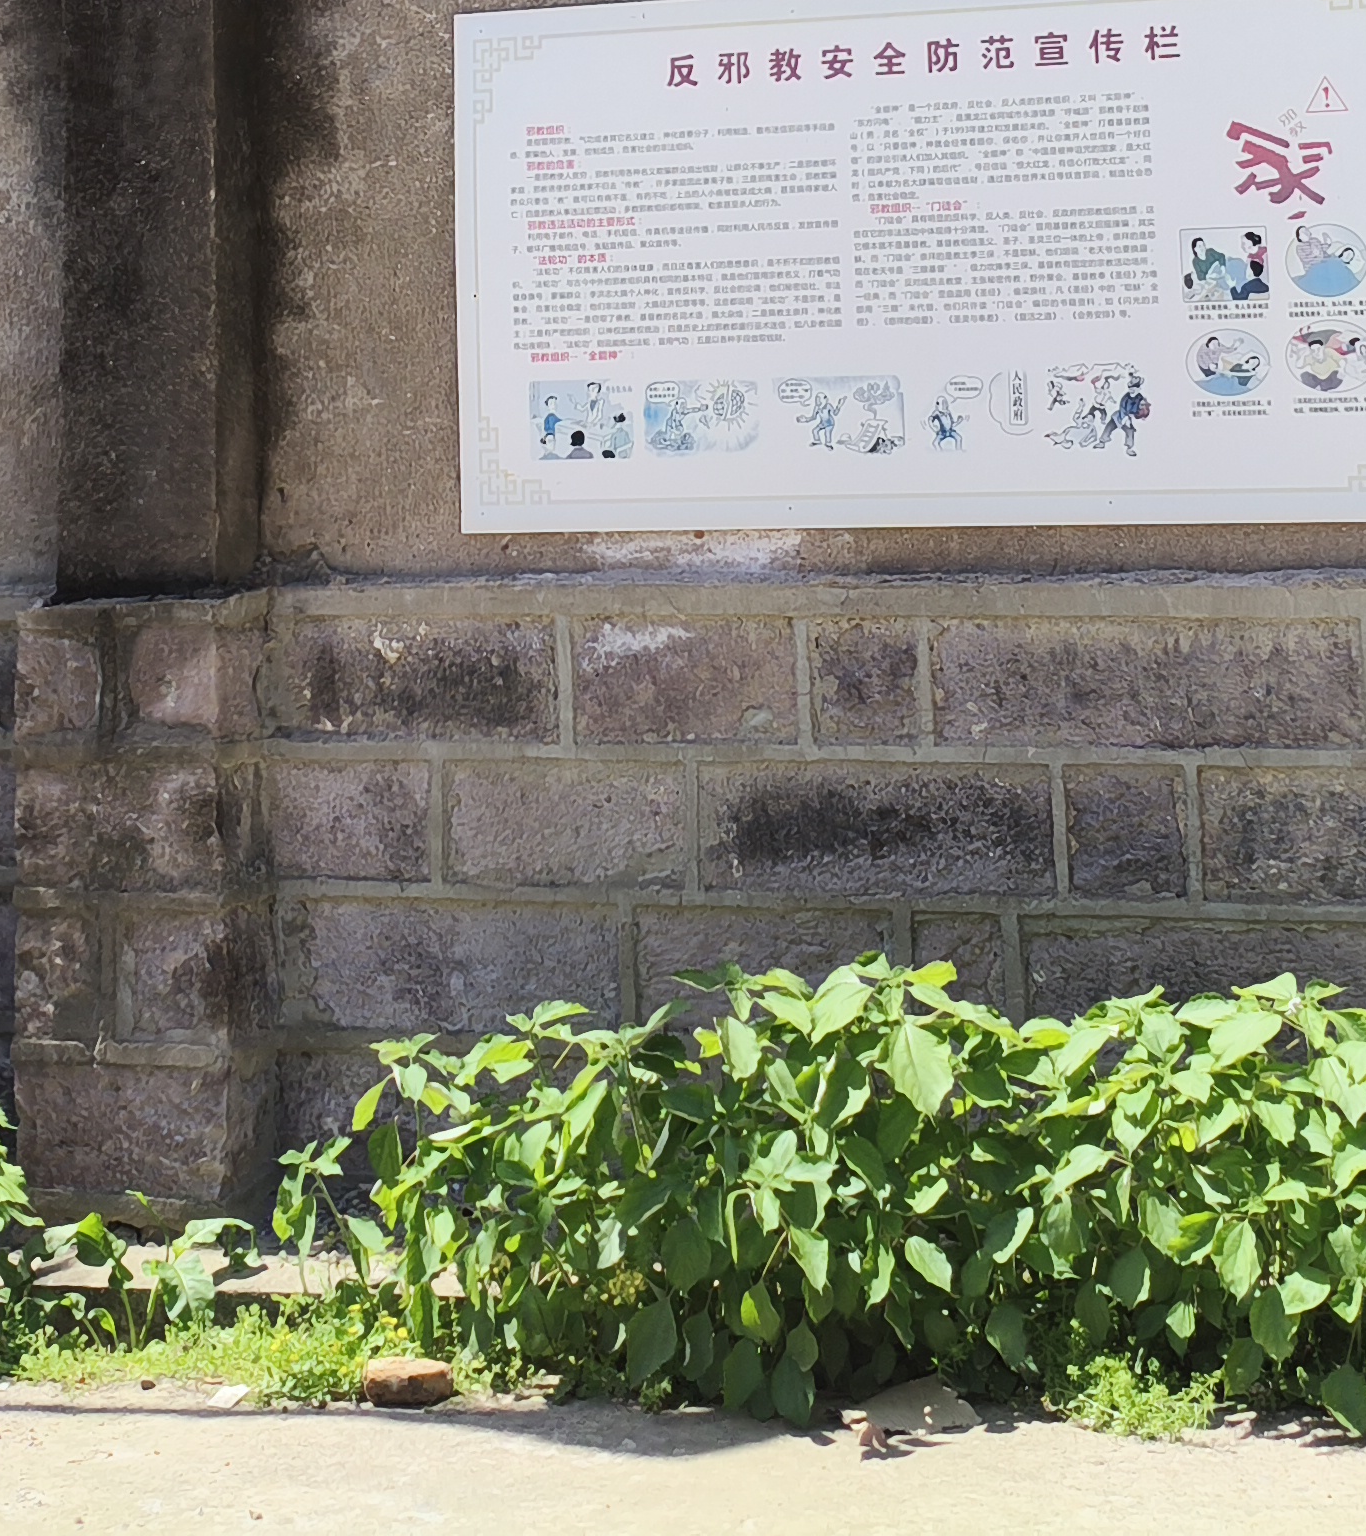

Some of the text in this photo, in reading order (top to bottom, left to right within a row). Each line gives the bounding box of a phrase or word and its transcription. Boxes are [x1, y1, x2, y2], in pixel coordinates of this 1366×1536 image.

[666, 25, 1182, 88] 反邪教安全防范宣传栏
[1012, 370, 1023, 421] 人民政府
